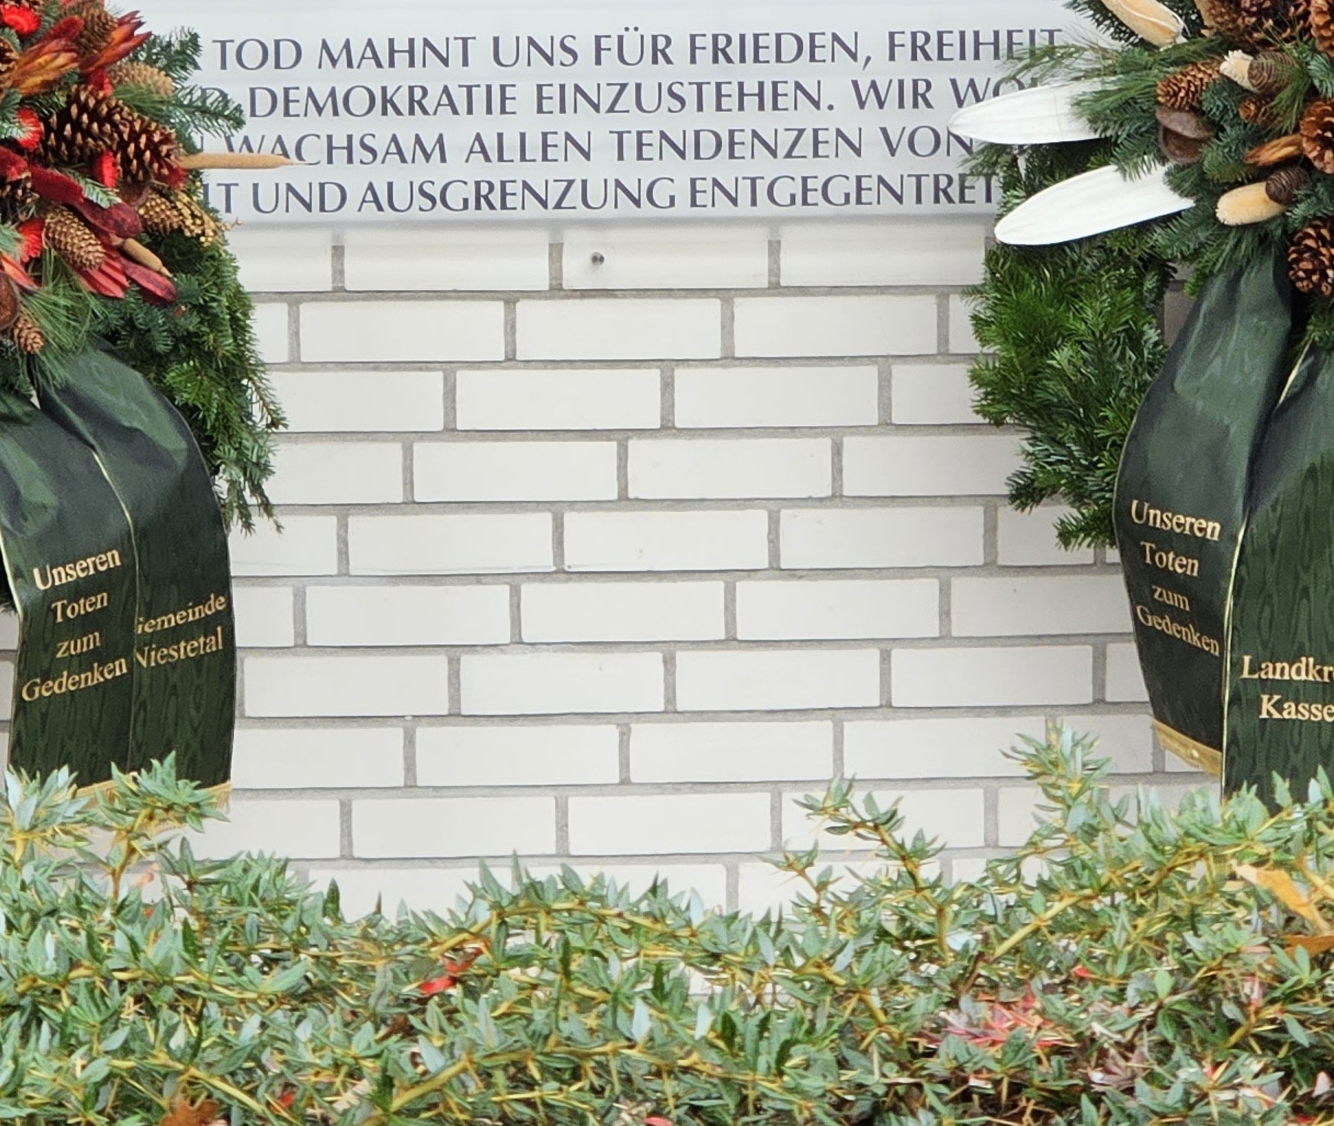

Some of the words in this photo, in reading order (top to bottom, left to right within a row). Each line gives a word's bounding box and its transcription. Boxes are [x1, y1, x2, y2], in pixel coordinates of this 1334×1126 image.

[212, 39, 302, 70] TOD
[318, 36, 476, 69] MAHNT
[493, 35, 578, 68] UNS
[594, 26, 674, 66] FÜR
[689, 31, 871, 71] FRIEDEN,
[888, 29, 1063, 62] FREIHEIT
[249, 84, 516, 117] DEMOKRATIE
[536, 79, 835, 115] EINZUSTEHEN.
[851, 78, 934, 110] WIR
[224, 132, 446, 165] WACHSAM
[465, 131, 591, 163] ALLEN
[609, 127, 862, 161] TENDENZEN
[879, 126, 974, 158] VON
[252, 182, 347, 215] UND
[357, 177, 675, 213] AUSGRENZUNG
[1130, 499, 1222, 542] Unseren
[33, 548, 122, 591] Unseren
[1140, 541, 1199, 577] Toten
[51, 591, 108, 623] Toten
[137, 593, 227, 635] emeinde
[1152, 585, 1190, 612] zum
[56, 630, 101, 658] zum
[1135, 604, 1220, 657] Gedenken
[21, 656, 128, 702] Gedenken
